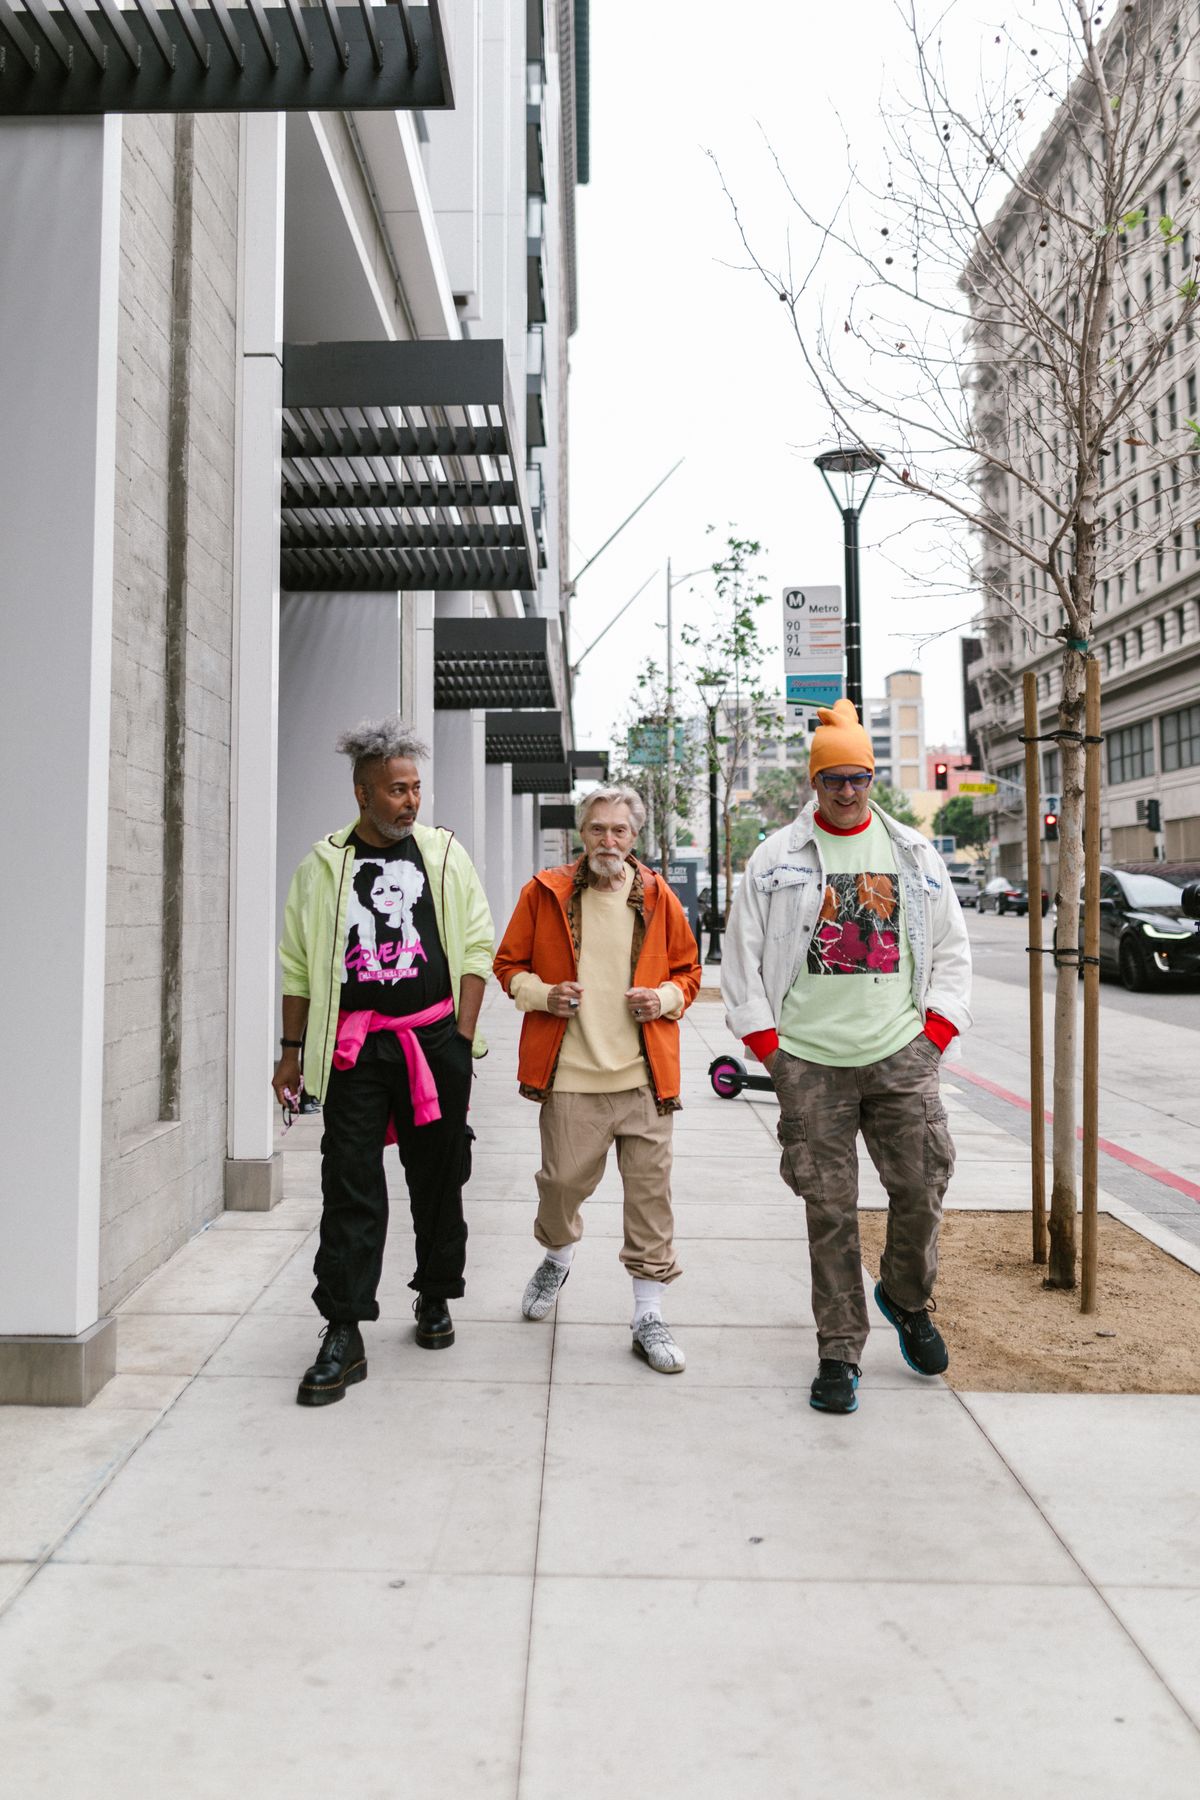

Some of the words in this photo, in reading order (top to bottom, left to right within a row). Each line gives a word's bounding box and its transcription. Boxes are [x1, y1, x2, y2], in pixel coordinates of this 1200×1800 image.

[809, 604, 839, 614] Metro
[786, 620, 801, 632] 90
[786, 634, 799, 645] 91
[786, 646, 801, 657] 94
[345, 938, 429, 972] CRUELLA
